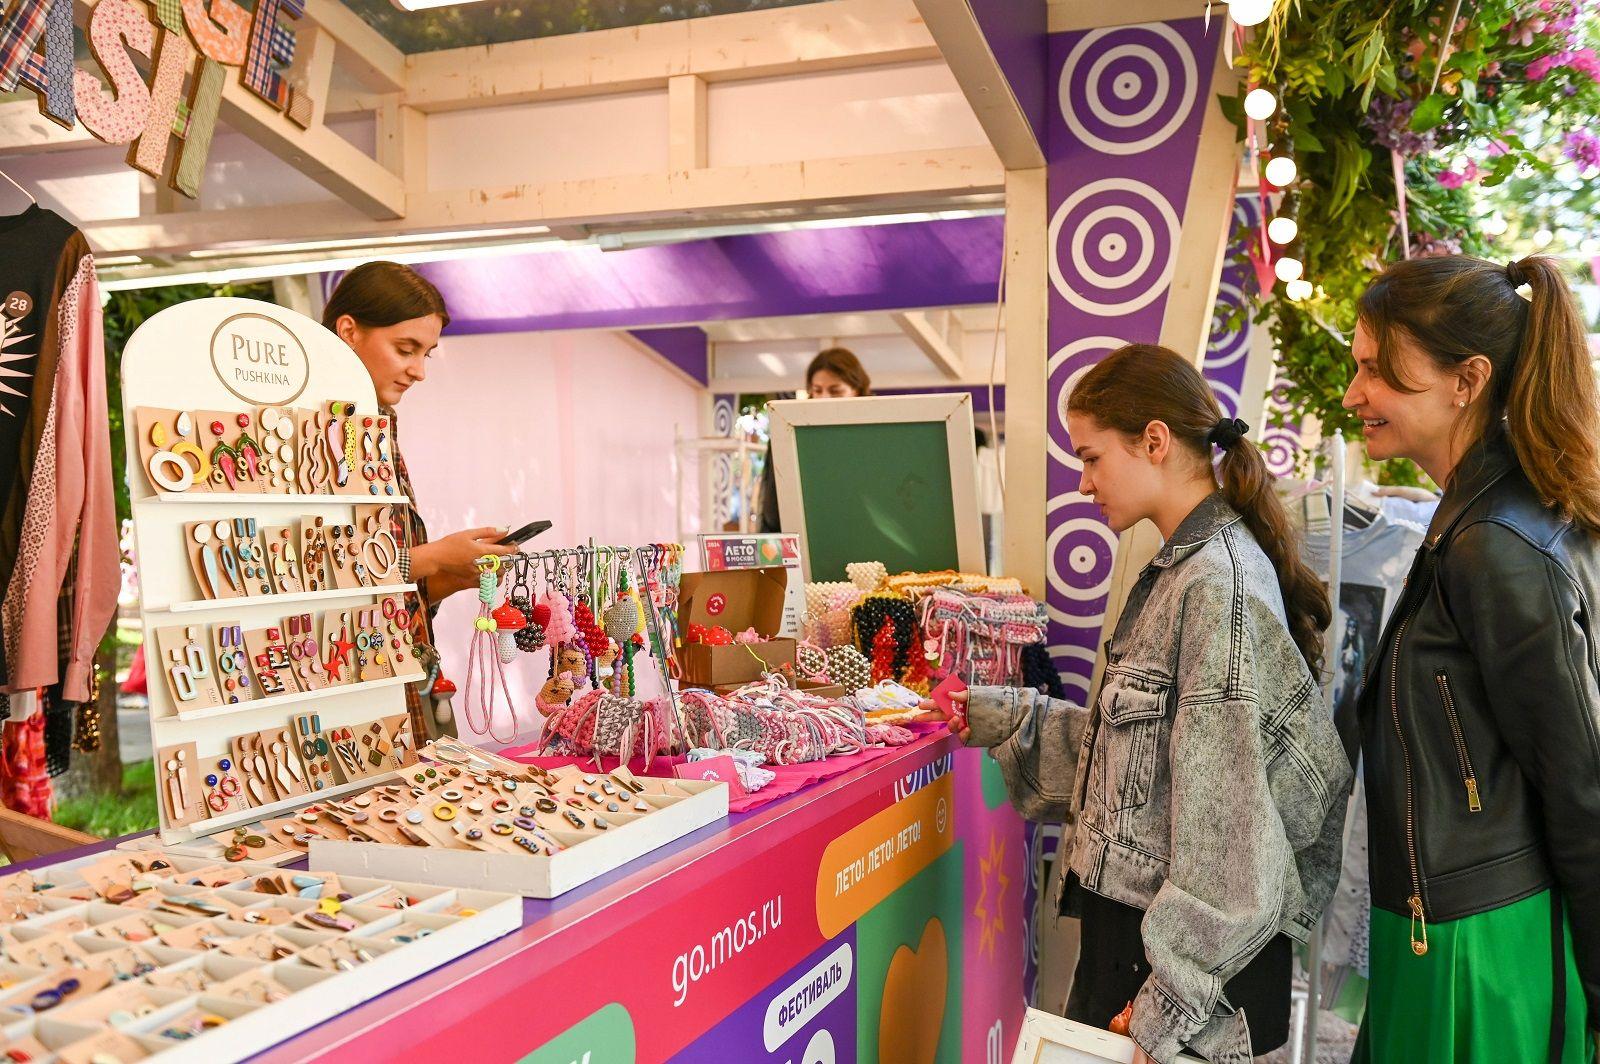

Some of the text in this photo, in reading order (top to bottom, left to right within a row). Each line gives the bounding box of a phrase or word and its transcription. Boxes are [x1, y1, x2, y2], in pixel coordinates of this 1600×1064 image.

[10, 297, 28, 311] 28
[231, 333, 289, 367] PURE
[235, 367, 290, 386] PUSHKINA
[725, 545, 755, 556] ЛЕТО
[835, 820, 921, 897] ЛЕТО! ЛЕТО! ЛЕТО!
[672, 894, 782, 1008] go.mos.ru
[778, 961, 842, 1028] ФЕСТИВАЛЬ
